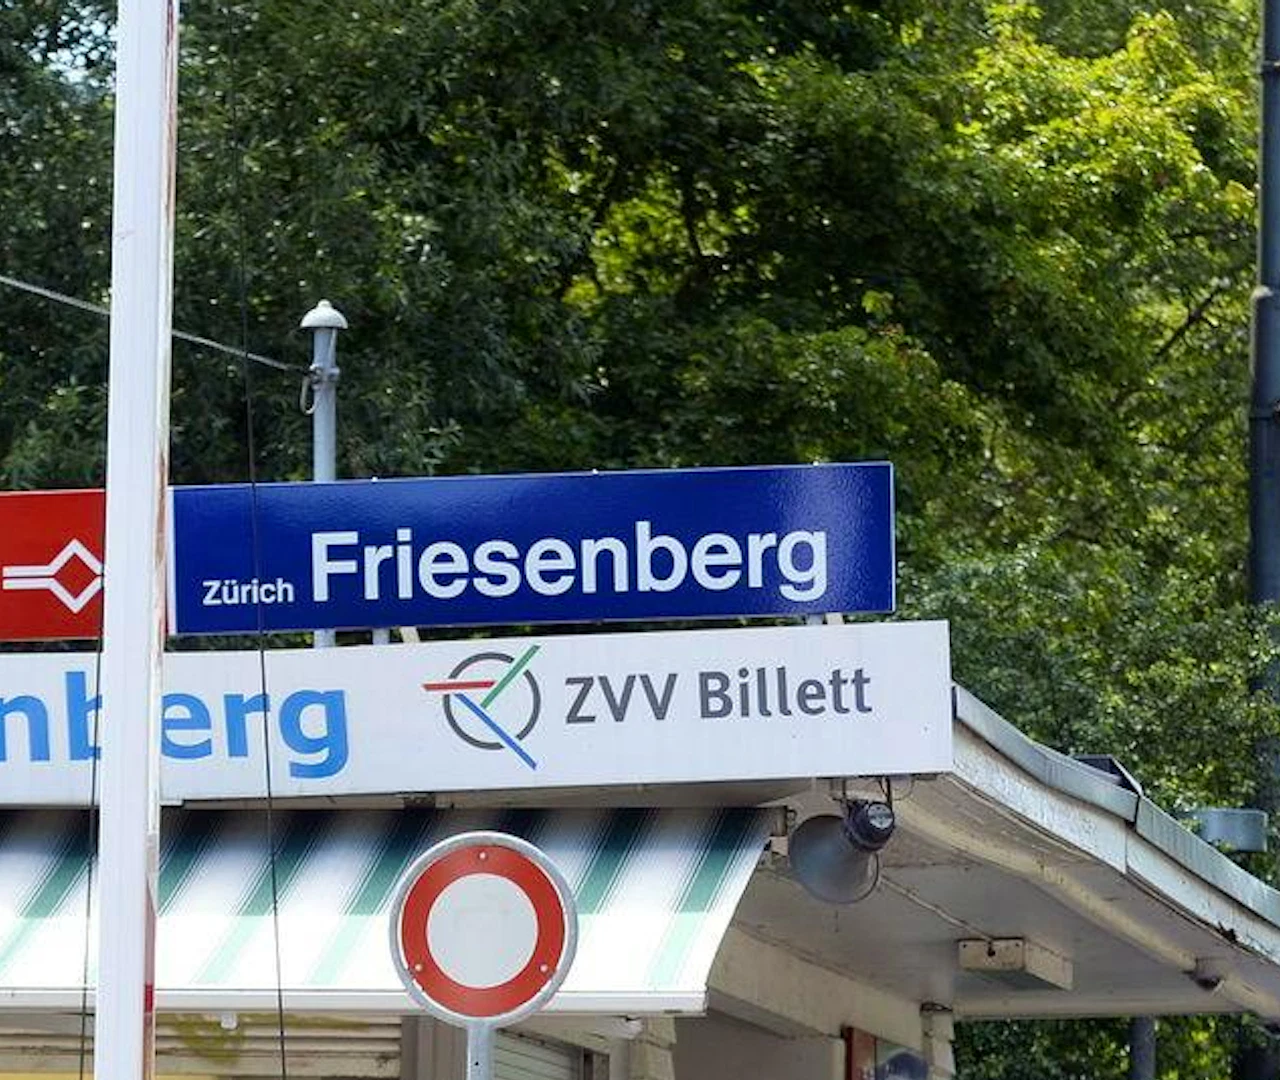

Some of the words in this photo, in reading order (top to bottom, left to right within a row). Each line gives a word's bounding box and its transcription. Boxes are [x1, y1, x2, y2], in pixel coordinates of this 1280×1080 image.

[202, 577, 295, 607] Zürich
[311, 520, 829, 602] Friesenberg
[565, 672, 678, 724] ZVV
[699, 666, 873, 720] Billett
